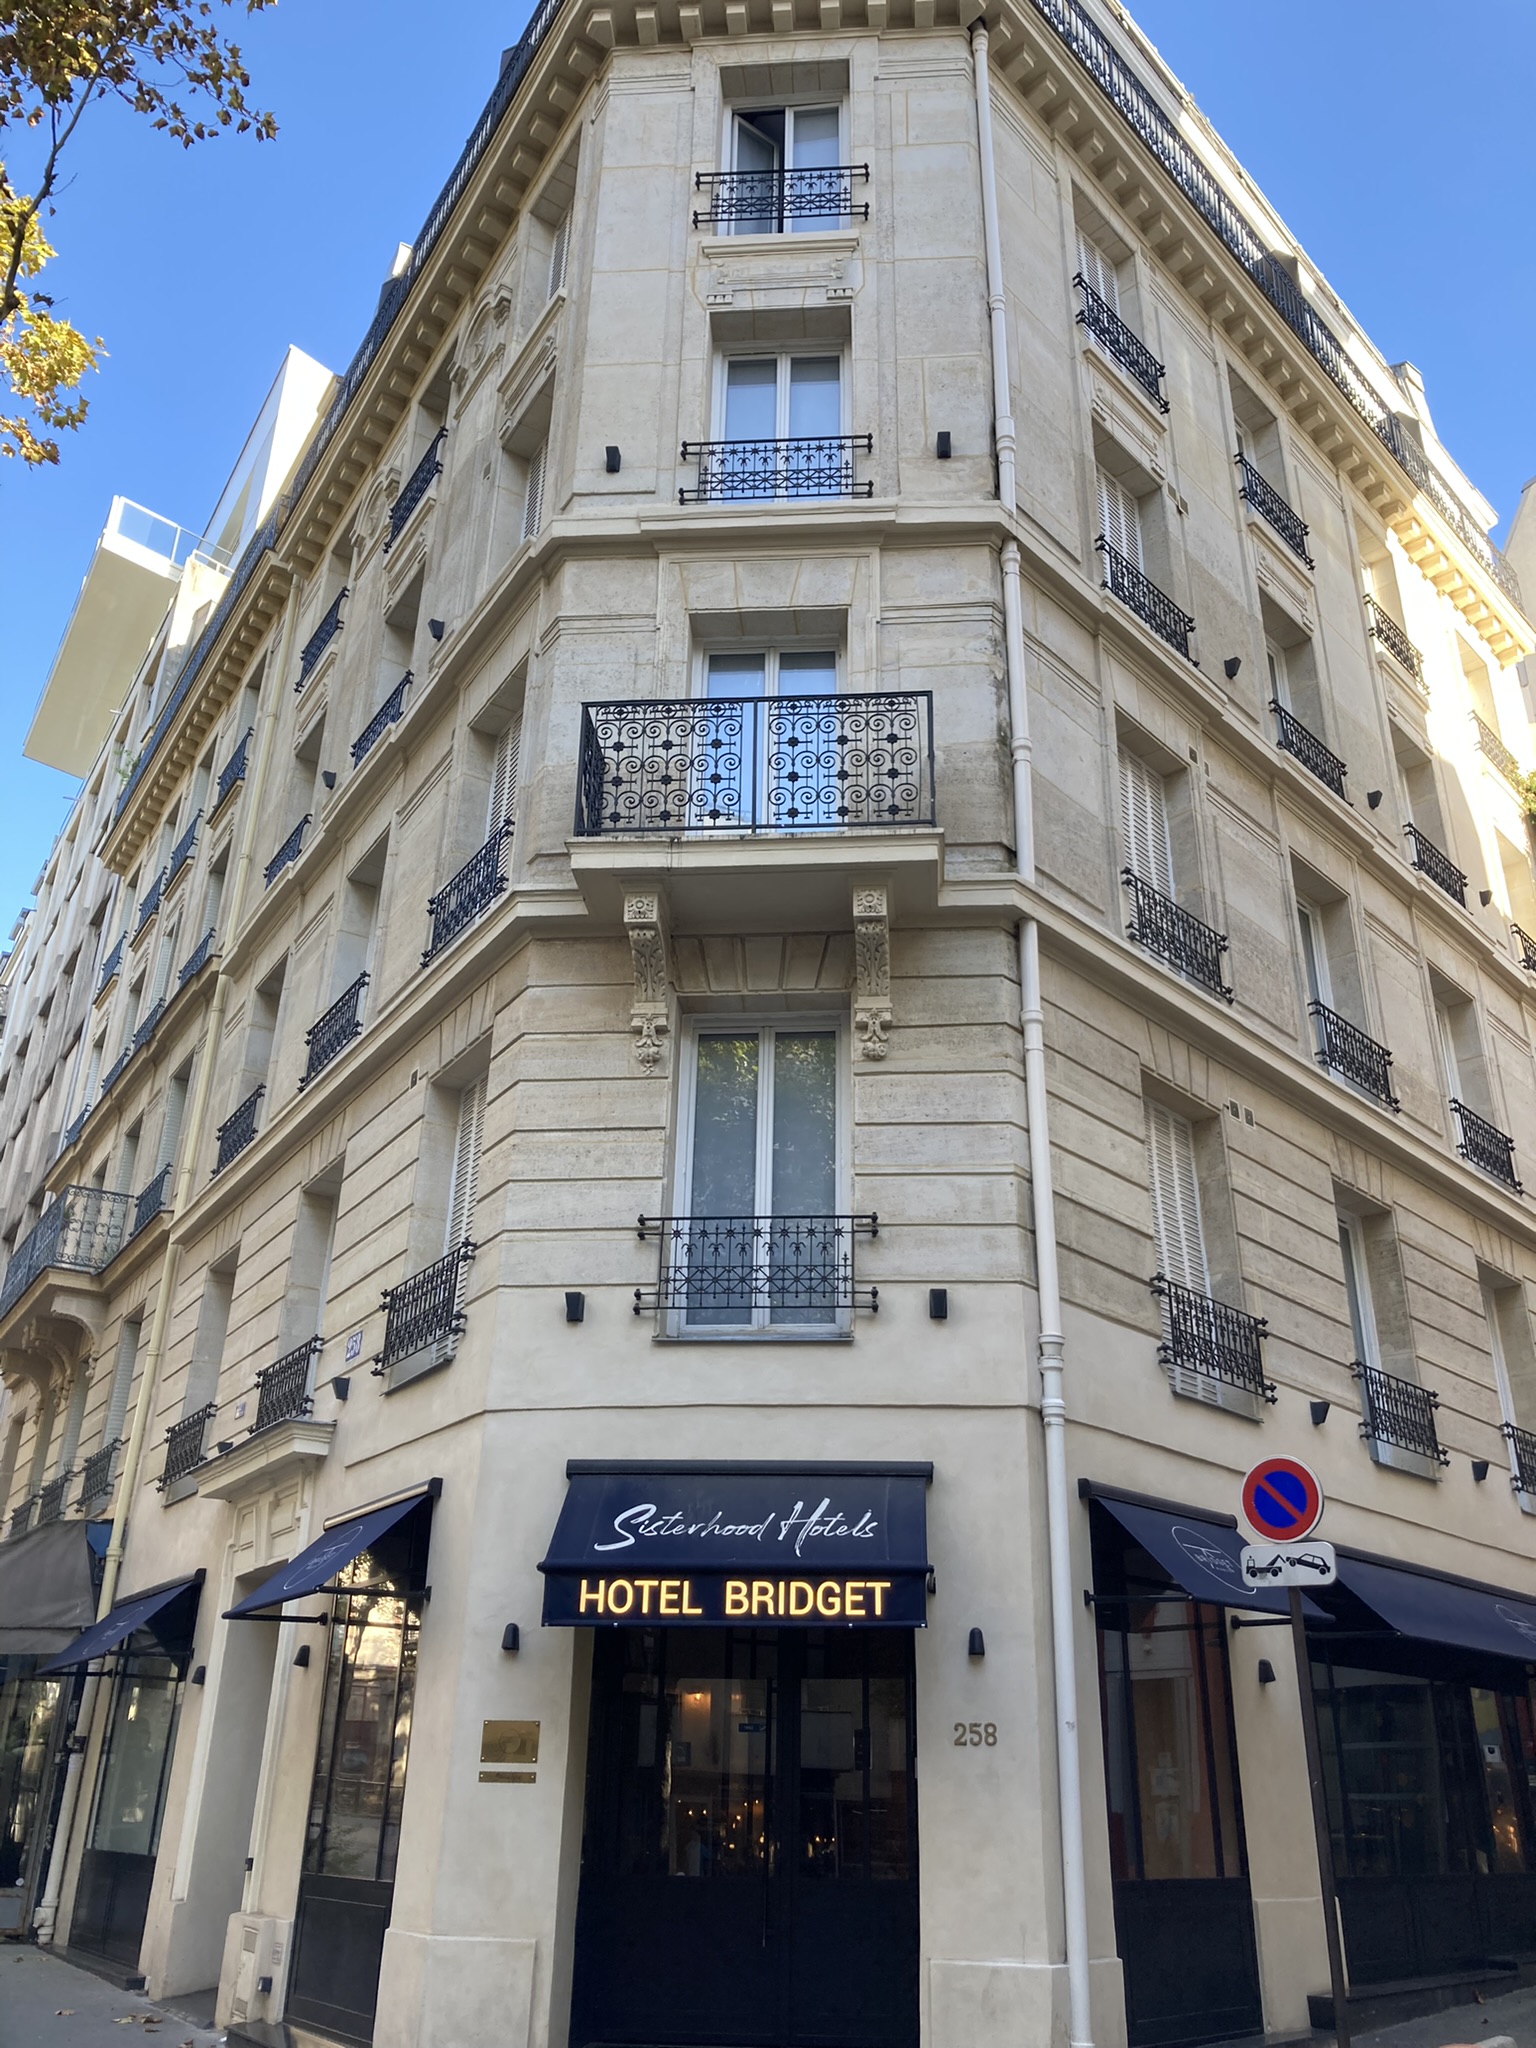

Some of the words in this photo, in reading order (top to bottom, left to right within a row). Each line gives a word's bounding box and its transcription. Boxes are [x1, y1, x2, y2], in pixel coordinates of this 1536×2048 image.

[594, 1503, 776, 1551] Sisterhood
[777, 1497, 879, 1557] Hotels
[579, 1579, 703, 1615] HOTEL
[725, 1580, 892, 1616] BRIDGET
[953, 1721, 998, 1747] 258
